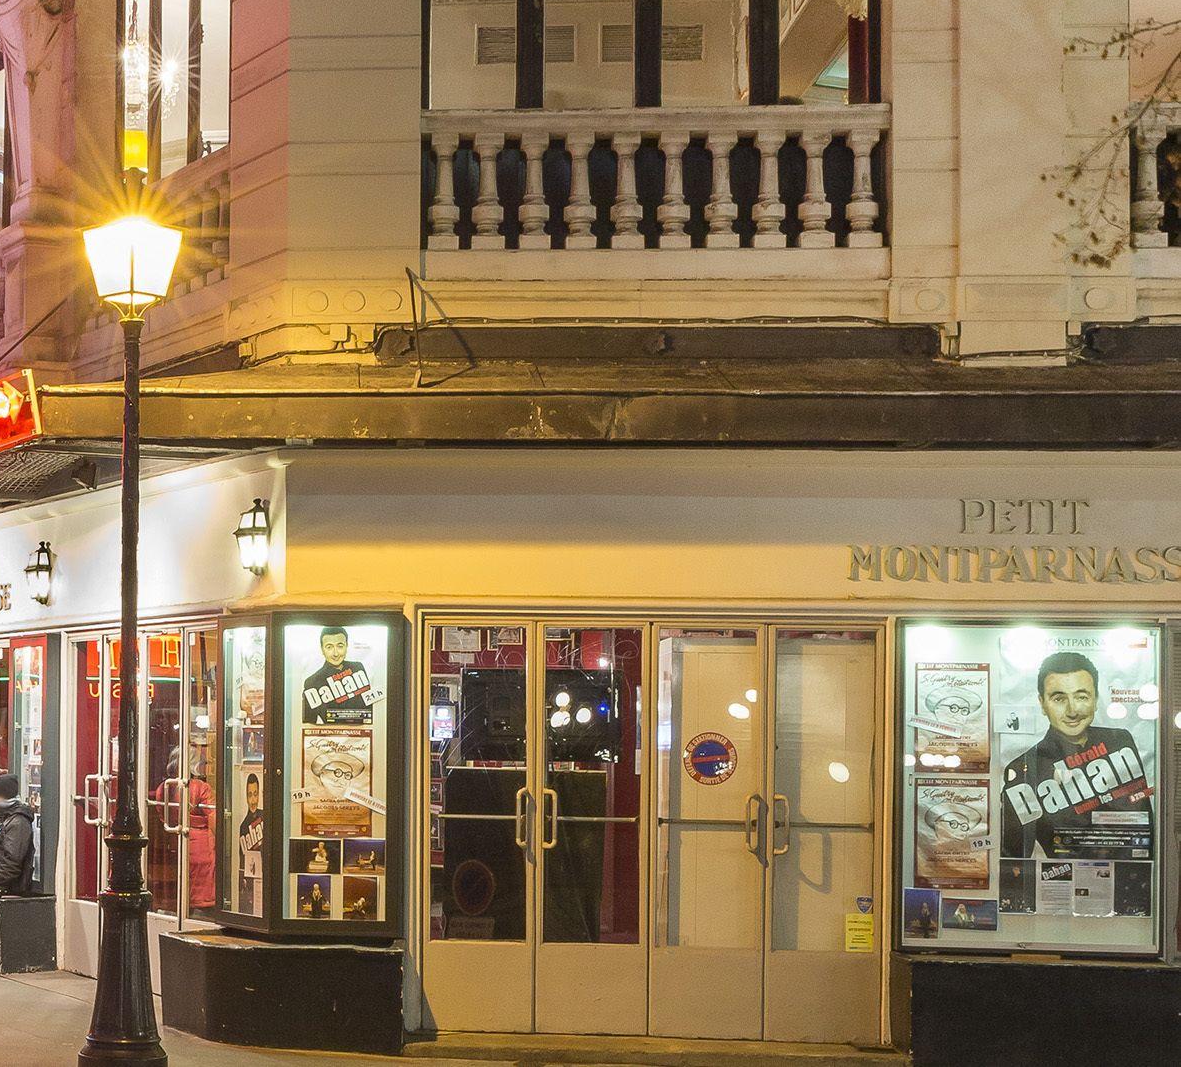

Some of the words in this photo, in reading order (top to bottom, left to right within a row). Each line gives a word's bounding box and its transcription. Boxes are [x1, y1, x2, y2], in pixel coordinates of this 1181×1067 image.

[959, 498, 1090, 535] PETIT
[847, 544, 1181, 584] MONTPARNASS
[304, 670, 370, 709] Dahan
[365, 691, 376, 701] 21
[1065, 741, 1108, 768] Gérald
[293, 792, 303, 800] 19
[1005, 746, 1144, 826] Dahan
[239, 821, 263, 854] Daha
[973, 840, 983, 848] 19
[1042, 863, 1071, 881] Dahan
